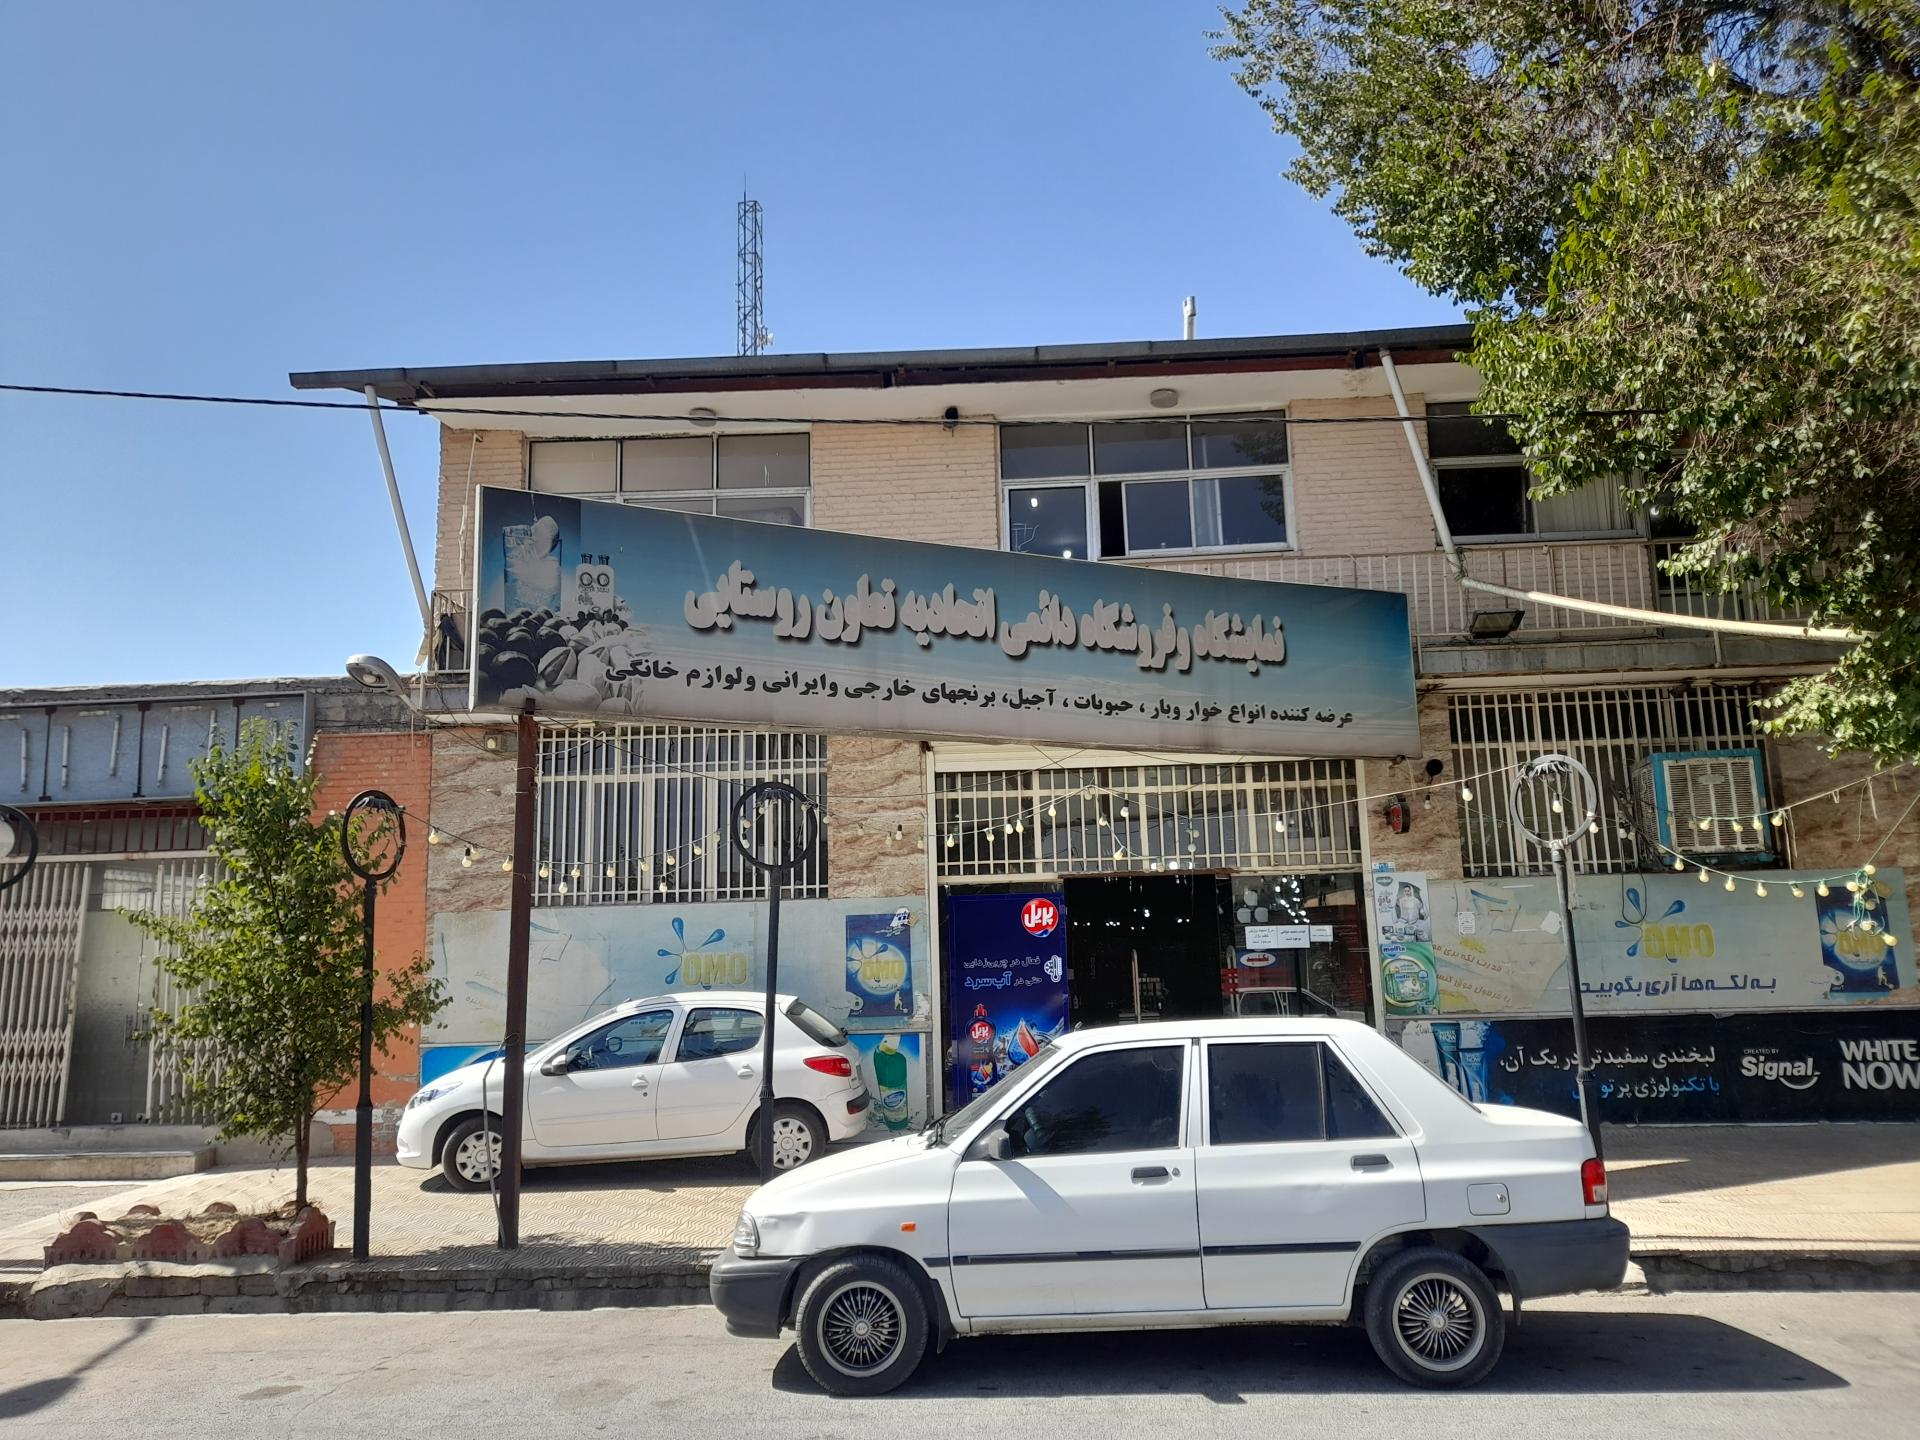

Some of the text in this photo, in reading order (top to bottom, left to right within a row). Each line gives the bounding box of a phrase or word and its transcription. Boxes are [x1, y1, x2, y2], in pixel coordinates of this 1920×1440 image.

[684, 559, 812, 639] روستایی
[815, 573, 896, 643] تعاون
[899, 582, 996, 646] اتحادیه
[1000, 589, 1077, 657] دائمی
[1193, 608, 1286, 673] نمایشگاه
[605, 658, 679, 682] خانگی
[844, 678, 916, 701] خارجی
[1073, 693, 1133, 716] حبوبات
[1185, 701, 1223, 721] خوار
[1227, 703, 1266, 724] انواع
[1270, 706, 1310, 721] کننده
[1314, 708, 1353, 728] عرضه
[1024, 903, 1054, 928] پریل
[1643, 923, 1716, 958] OMO
[682, 952, 747, 985] OMO
[1009, 959, 1021, 967] در
[1014, 977, 1024, 986] در
[1581, 975, 1642, 998] بگویید
[1645, 973, 1678, 996] آری
[1751, 976, 1777, 994] به
[1530, 1047, 1559, 1069] یک
[1652, 1045, 1716, 1069] لبخندی
[1839, 1039, 1919, 1062] WHITE
[1741, 1055, 1814, 1081] Signal
[1842, 1061, 1920, 1090] NOW
[1635, 1076, 1706, 1099] تکنولوژی
[1708, 1076, 1720, 1096] با
